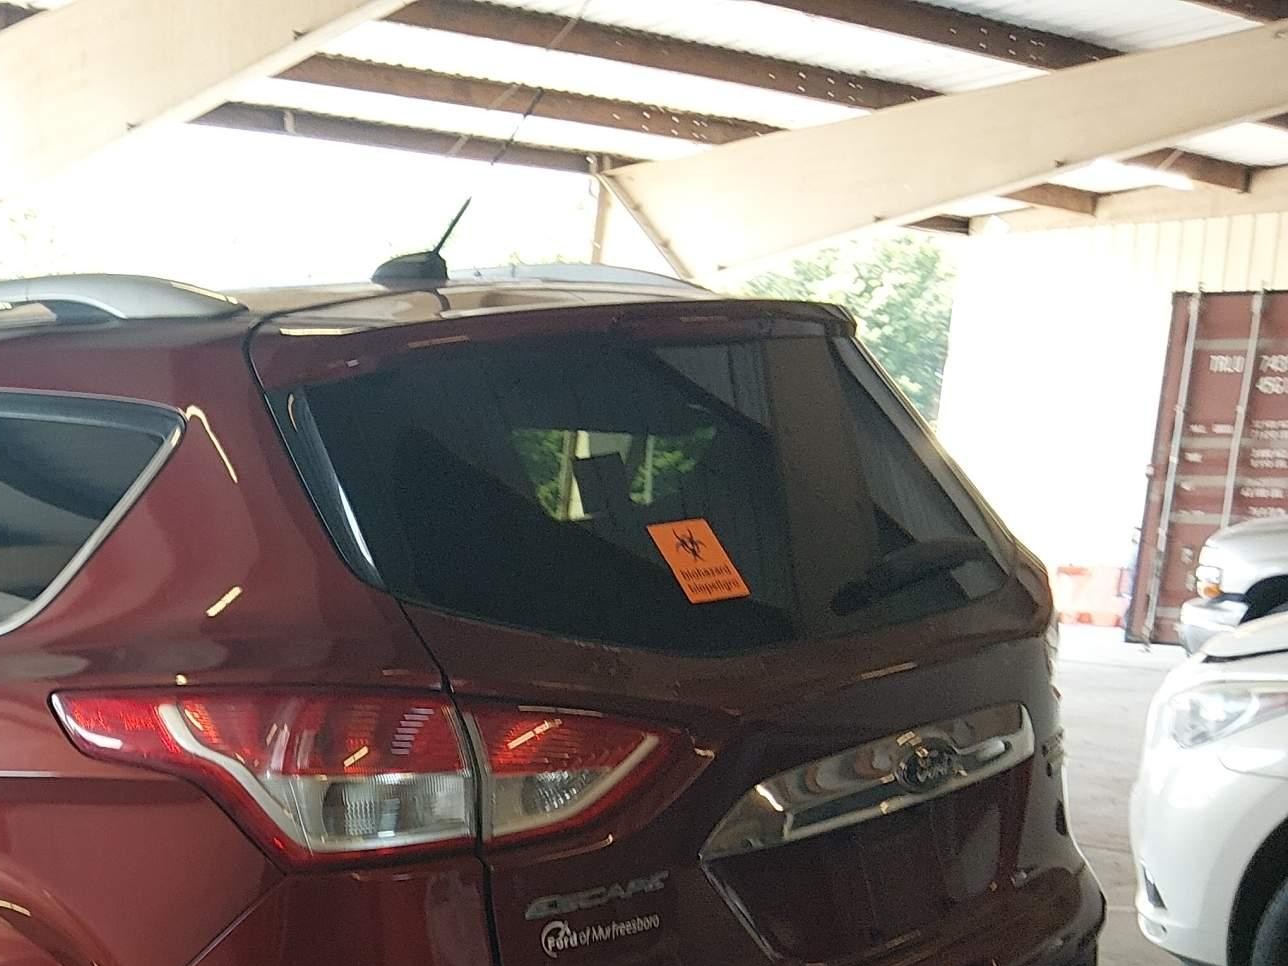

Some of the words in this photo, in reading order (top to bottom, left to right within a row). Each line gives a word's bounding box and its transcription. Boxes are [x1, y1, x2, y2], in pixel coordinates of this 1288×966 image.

[547, 931, 578, 952] Ford
[579, 925, 590, 945] of
[592, 914, 660, 942] Murfreesboro
